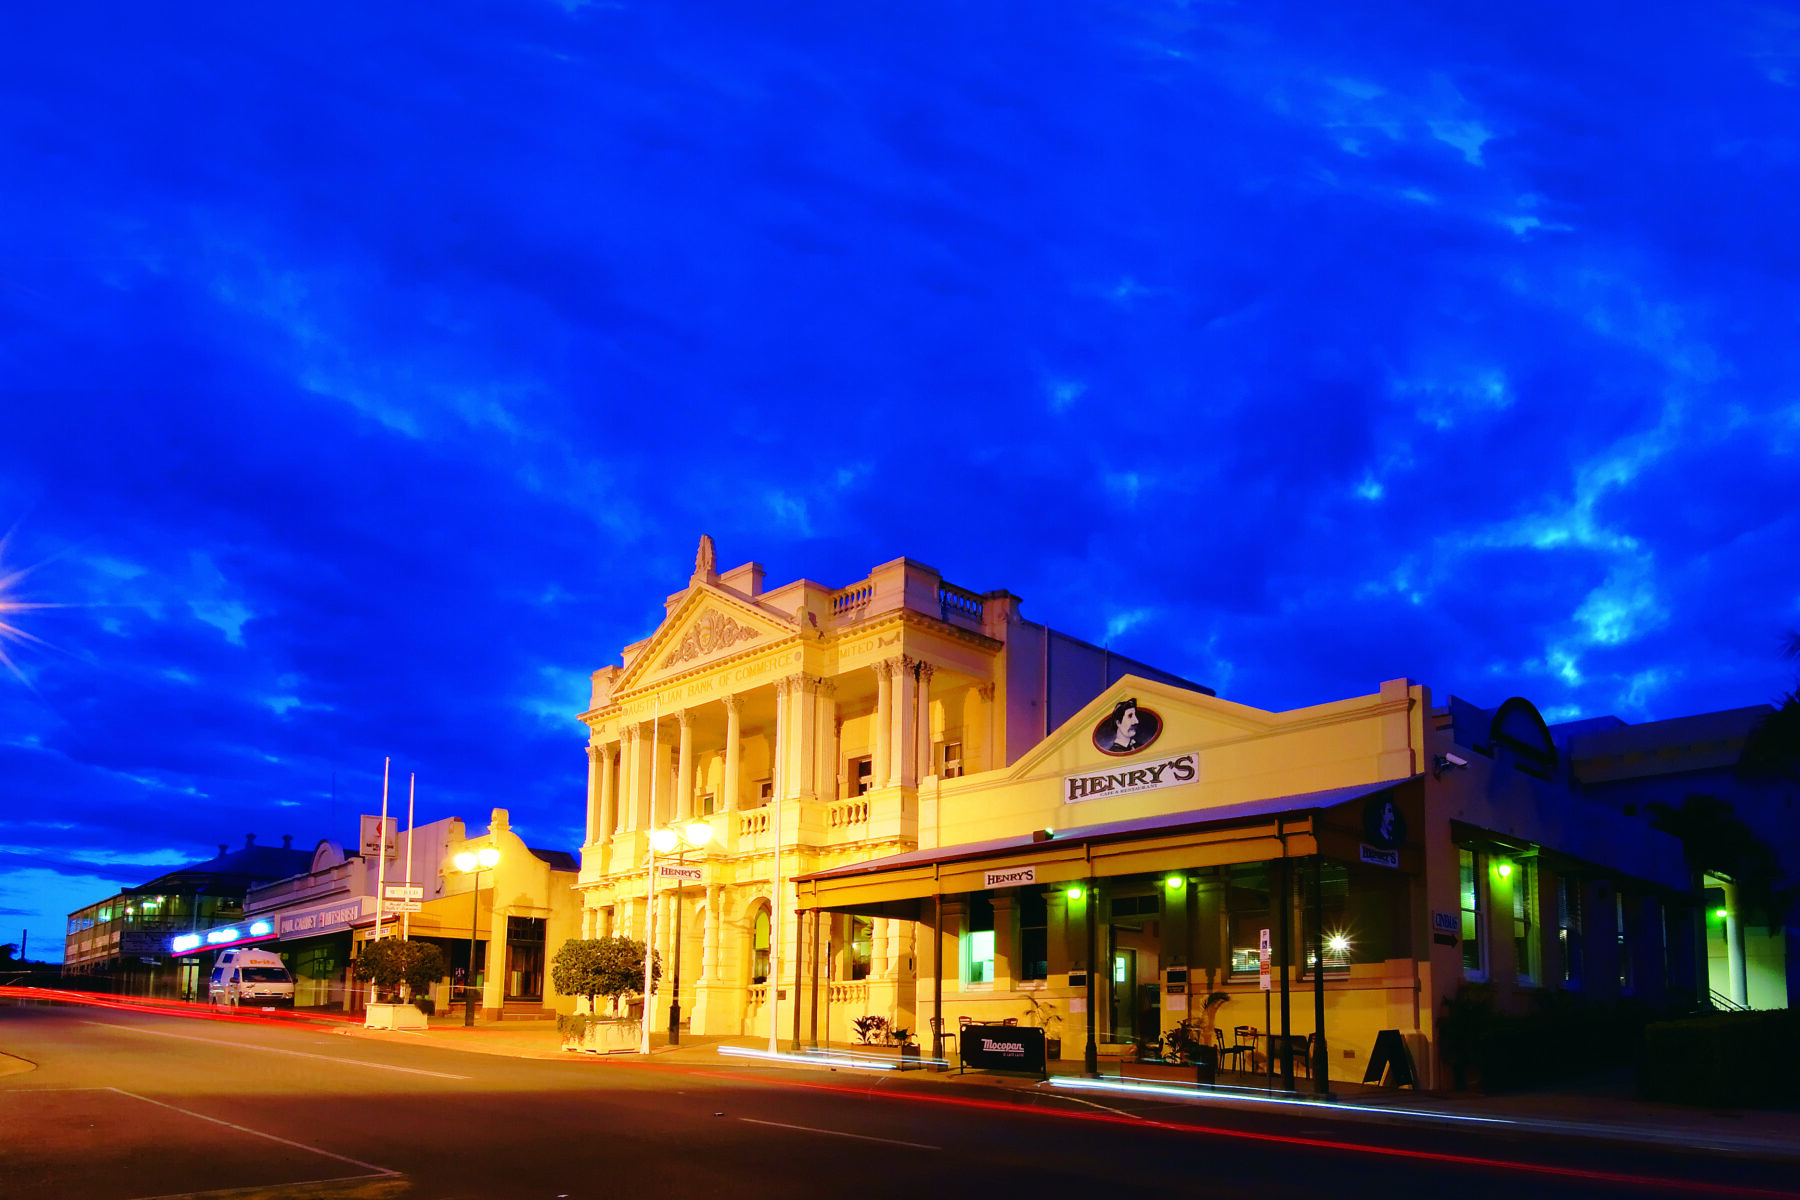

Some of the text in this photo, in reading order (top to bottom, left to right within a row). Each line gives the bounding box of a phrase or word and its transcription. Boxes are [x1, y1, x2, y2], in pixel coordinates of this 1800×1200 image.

[688, 680, 714, 698] BANK
[719, 674, 730, 688] OF
[735, 653, 793, 682] COMMERCE
[1068, 755, 1196, 801] HENRY'S
[661, 867, 701, 879] HENRY'S
[987, 869, 1034, 885] HENRY'S
[981, 1038, 1024, 1052] Mocopan
